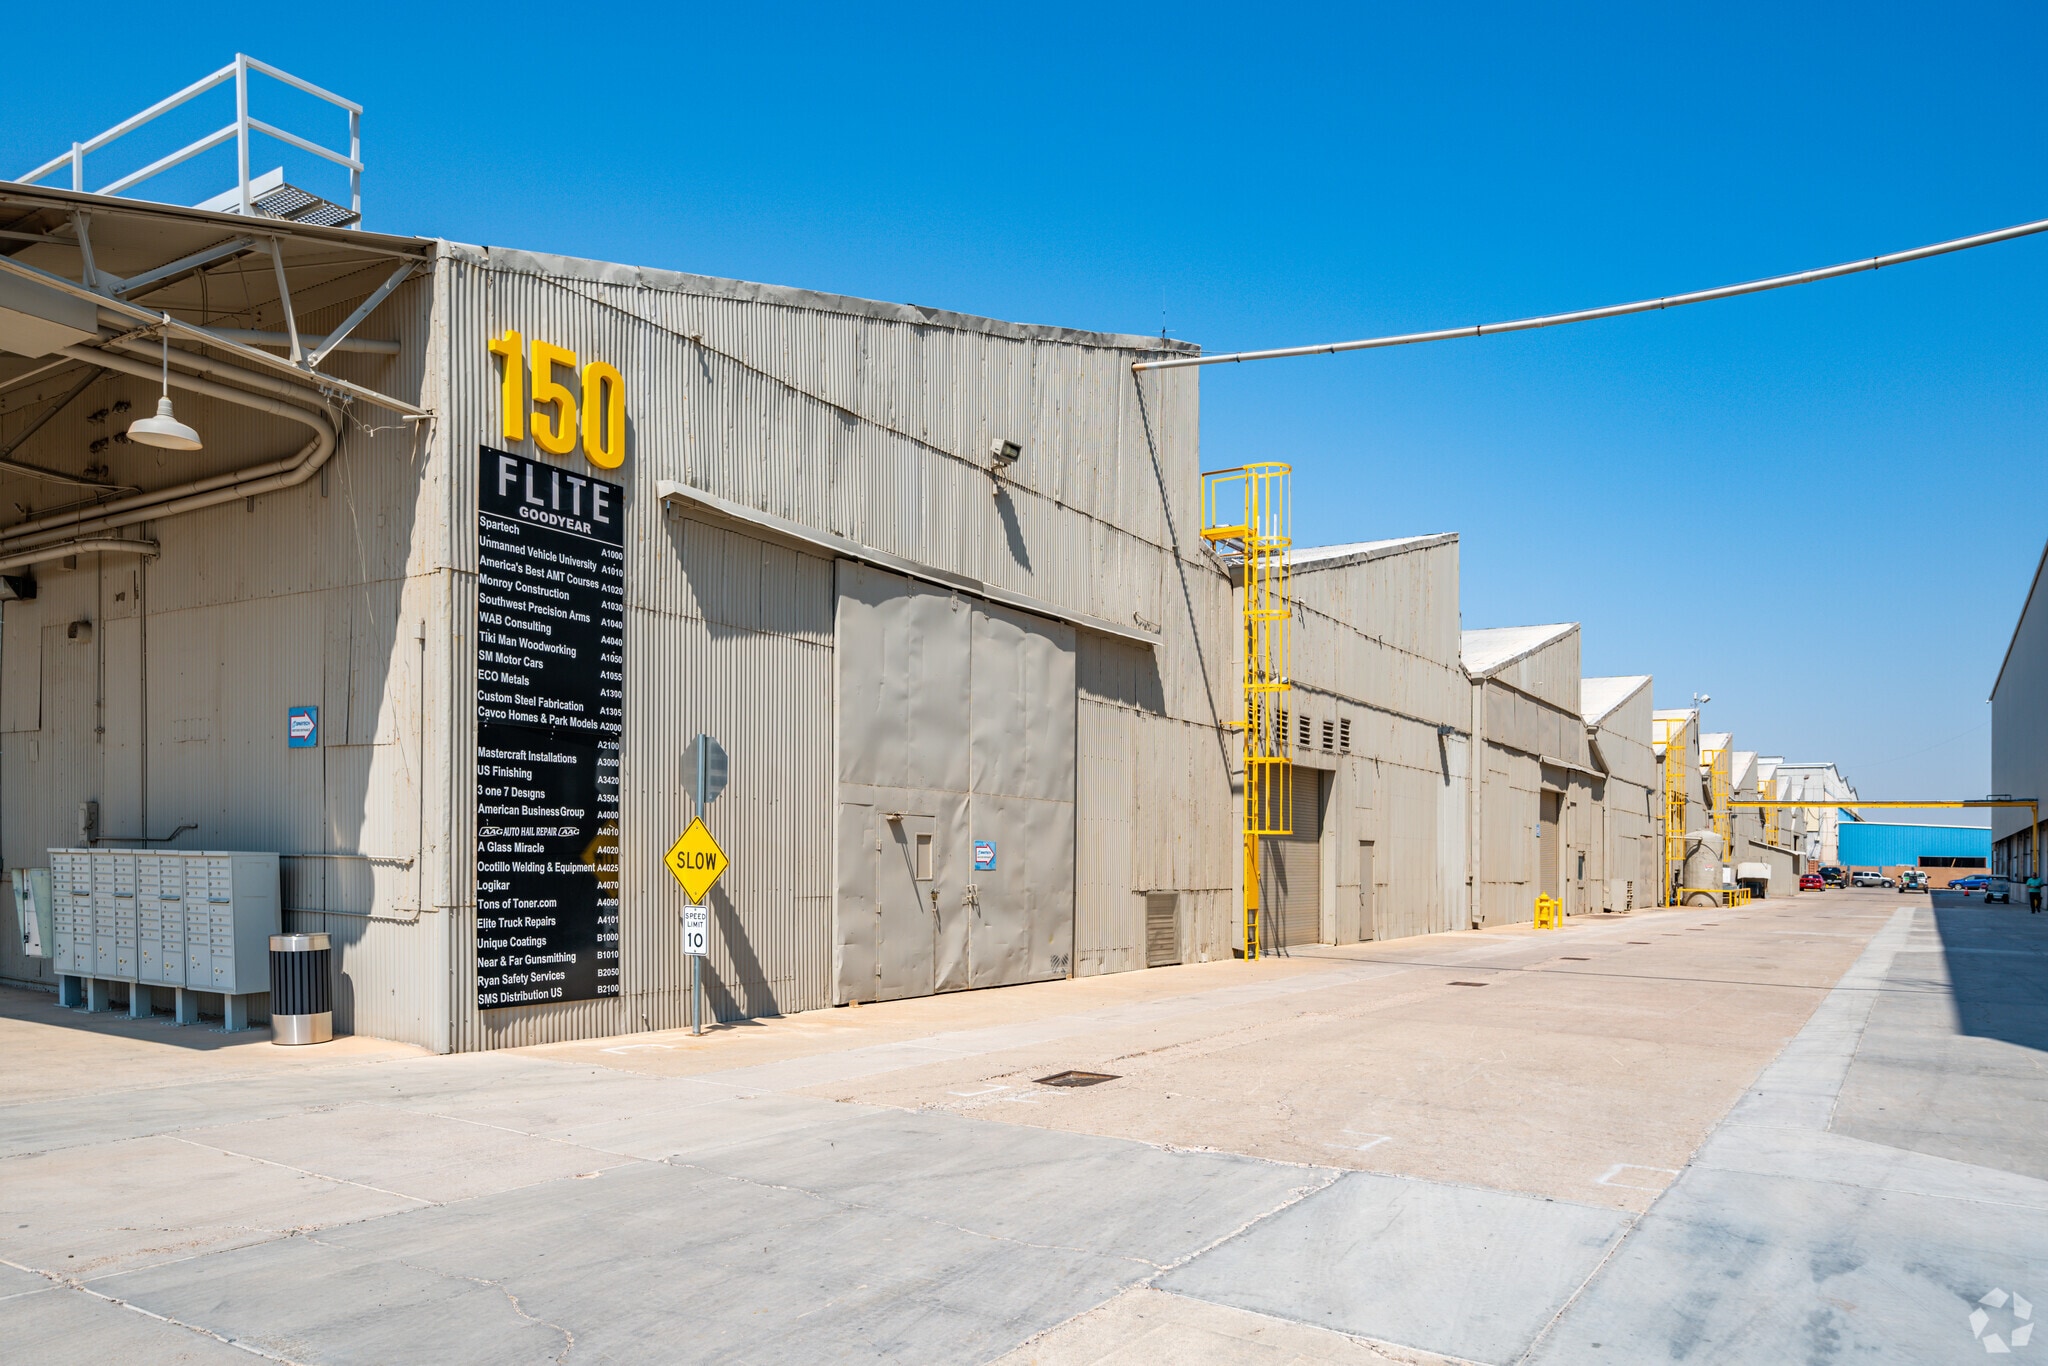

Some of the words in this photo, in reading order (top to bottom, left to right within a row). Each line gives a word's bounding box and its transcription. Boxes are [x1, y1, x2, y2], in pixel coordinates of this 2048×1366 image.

[488, 330, 625, 470] 150
[498, 455, 610, 524] FLITE
[519, 506, 592, 535] GOODYEAR
[480, 516, 520, 534] Spartech
[602, 548, 623, 560] A1000
[480, 536, 526, 555] Unmanned
[527, 546, 558, 562] Vehicle
[559, 553, 597, 572] University
[602, 566, 624, 577] A1010
[480, 555, 523, 573] America's
[526, 564, 546, 578] Best
[546, 568, 566, 582] AMT
[566, 574, 599, 588] Courses
[602, 584, 624, 596] A1020
[480, 573, 513, 591] Monroy
[516, 580, 570, 600] Construction
[602, 600, 624, 612] A1030
[480, 592, 526, 611] Southwest
[528, 602, 568, 619] Precision
[568, 610, 591, 623] Arms
[601, 618, 623, 630] A1040
[480, 611, 502, 625] WAB
[504, 616, 552, 636] Consulting
[601, 635, 623, 646] A4040
[479, 631, 496, 644] Tiki
[498, 634, 517, 647] Man
[519, 638, 577, 658] Woodworking
[600, 652, 622, 664] A1050
[478, 650, 493, 662] SM
[496, 652, 520, 666] Motor
[524, 656, 544, 670] Cars
[600, 670, 622, 681] A1055
[478, 670, 498, 682] ECO
[501, 672, 530, 686] Metals
[478, 690, 512, 704] Custom
[515, 694, 537, 707] Steel
[538, 697, 584, 712] Fabrication
[600, 706, 622, 716] A1305
[478, 706, 506, 719] Cavco
[508, 710, 538, 724] Homes
[541, 712, 549, 724] &
[550, 714, 568, 727] Park
[570, 716, 598, 730] Models
[600, 722, 622, 732] A2000
[598, 740, 620, 750] A2100
[478, 746, 526, 761] Mastercraft
[528, 751, 577, 764] Installations
[598, 758, 620, 767] A3000
[478, 764, 490, 776] US
[492, 766, 532, 780] Finishing
[598, 776, 620, 784] A3420
[478, 784, 484, 795] 3
[486, 788, 502, 797] one
[504, 786, 510, 797] 7
[512, 786, 546, 800] Designs
[597, 794, 619, 802] A3504
[478, 803, 520, 816] American
[522, 805, 560, 816] Business
[560, 806, 585, 818] Group
[598, 810, 619, 819] A4000
[503, 827, 520, 836] AUTO
[520, 827, 535, 836] HAIL
[536, 827, 558, 836] REPAIR
[597, 828, 619, 836] A4010
[478, 842, 485, 852] A
[487, 842, 512, 852] Glass
[514, 842, 544, 853] Miracle
[597, 846, 619, 854] A4020
[478, 860, 510, 872] Ocotillo
[512, 862, 545, 874] Welding
[547, 862, 554, 872] &
[554, 862, 596, 874] Equipment
[597, 864, 619, 872] A4025
[677, 852, 716, 870] SLOW
[477, 880, 510, 892] Logikar
[597, 881, 619, 890] A4070
[478, 898, 500, 910] Tons
[502, 898, 512, 909] of
[513, 898, 557, 909] Toner.com
[597, 898, 619, 906] A4090
[477, 918, 496, 929] Elite
[498, 917, 523, 928] Truck
[525, 916, 556, 928] Repairs
[598, 916, 619, 924] A4101
[686, 912, 706, 920] SPEED
[478, 938, 508, 950] Unique
[510, 936, 547, 948] Coatings
[597, 934, 619, 942] B1000
[688, 933, 703, 948] 10
[478, 956, 498, 968] Near
[500, 956, 508, 967] &
[510, 955, 523, 966] Far
[524, 952, 576, 965] Gunsmithing
[597, 951, 619, 960] B1010
[478, 975, 500, 988] Ryan
[502, 973, 528, 985] Safety
[530, 970, 566, 982] Services
[598, 968, 620, 977] B2050
[478, 994, 498, 1005] SMS
[501, 988, 549, 1003] Distribution
[550, 987, 564, 999] US
[598, 984, 620, 994] B2100
